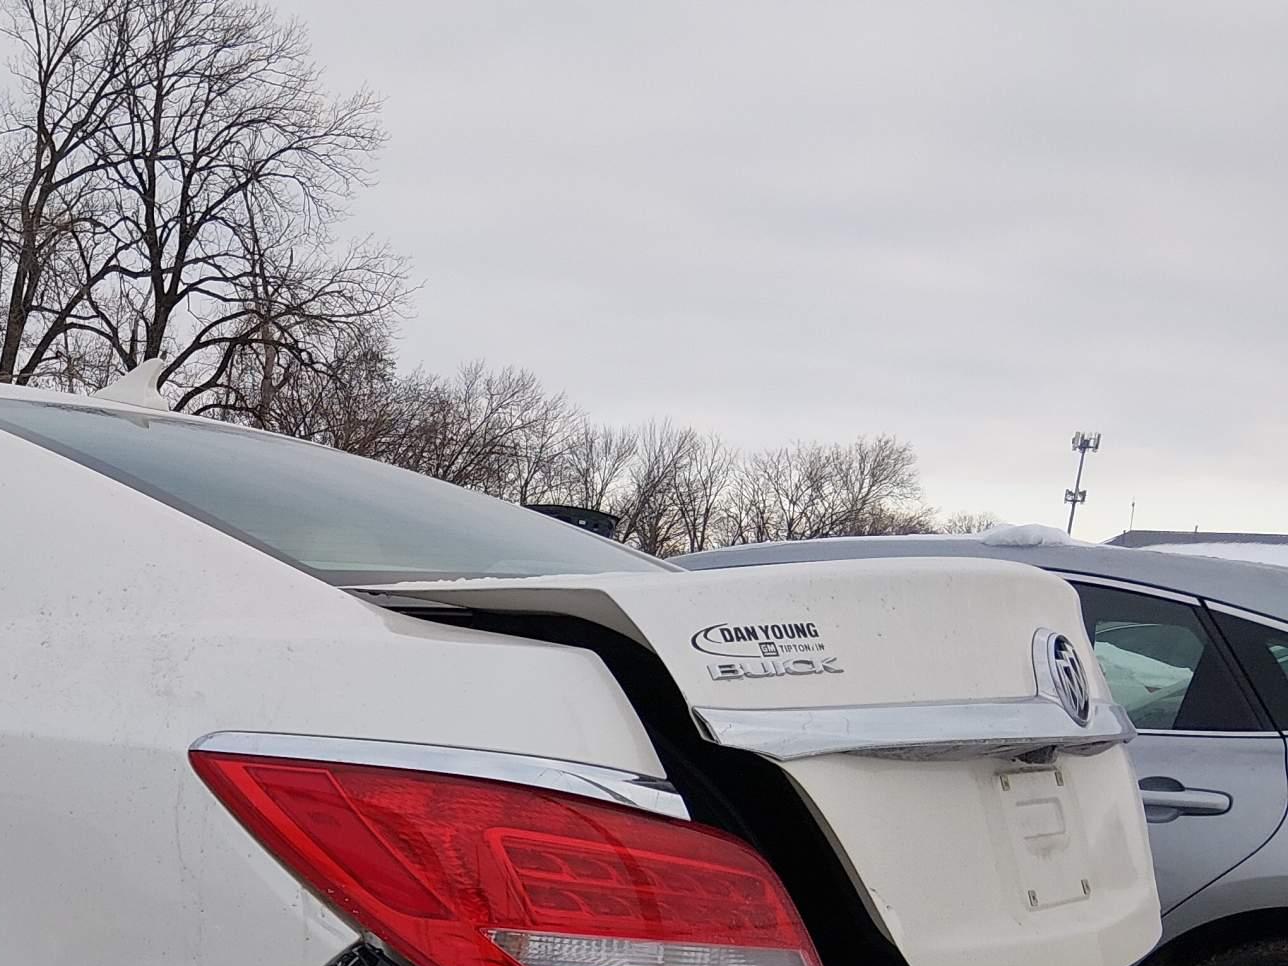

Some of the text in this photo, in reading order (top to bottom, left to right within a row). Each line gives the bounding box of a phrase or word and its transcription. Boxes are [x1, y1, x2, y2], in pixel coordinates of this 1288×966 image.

[720, 622, 820, 642] DAN YOUNG
[707, 657, 844, 680] BUICK
